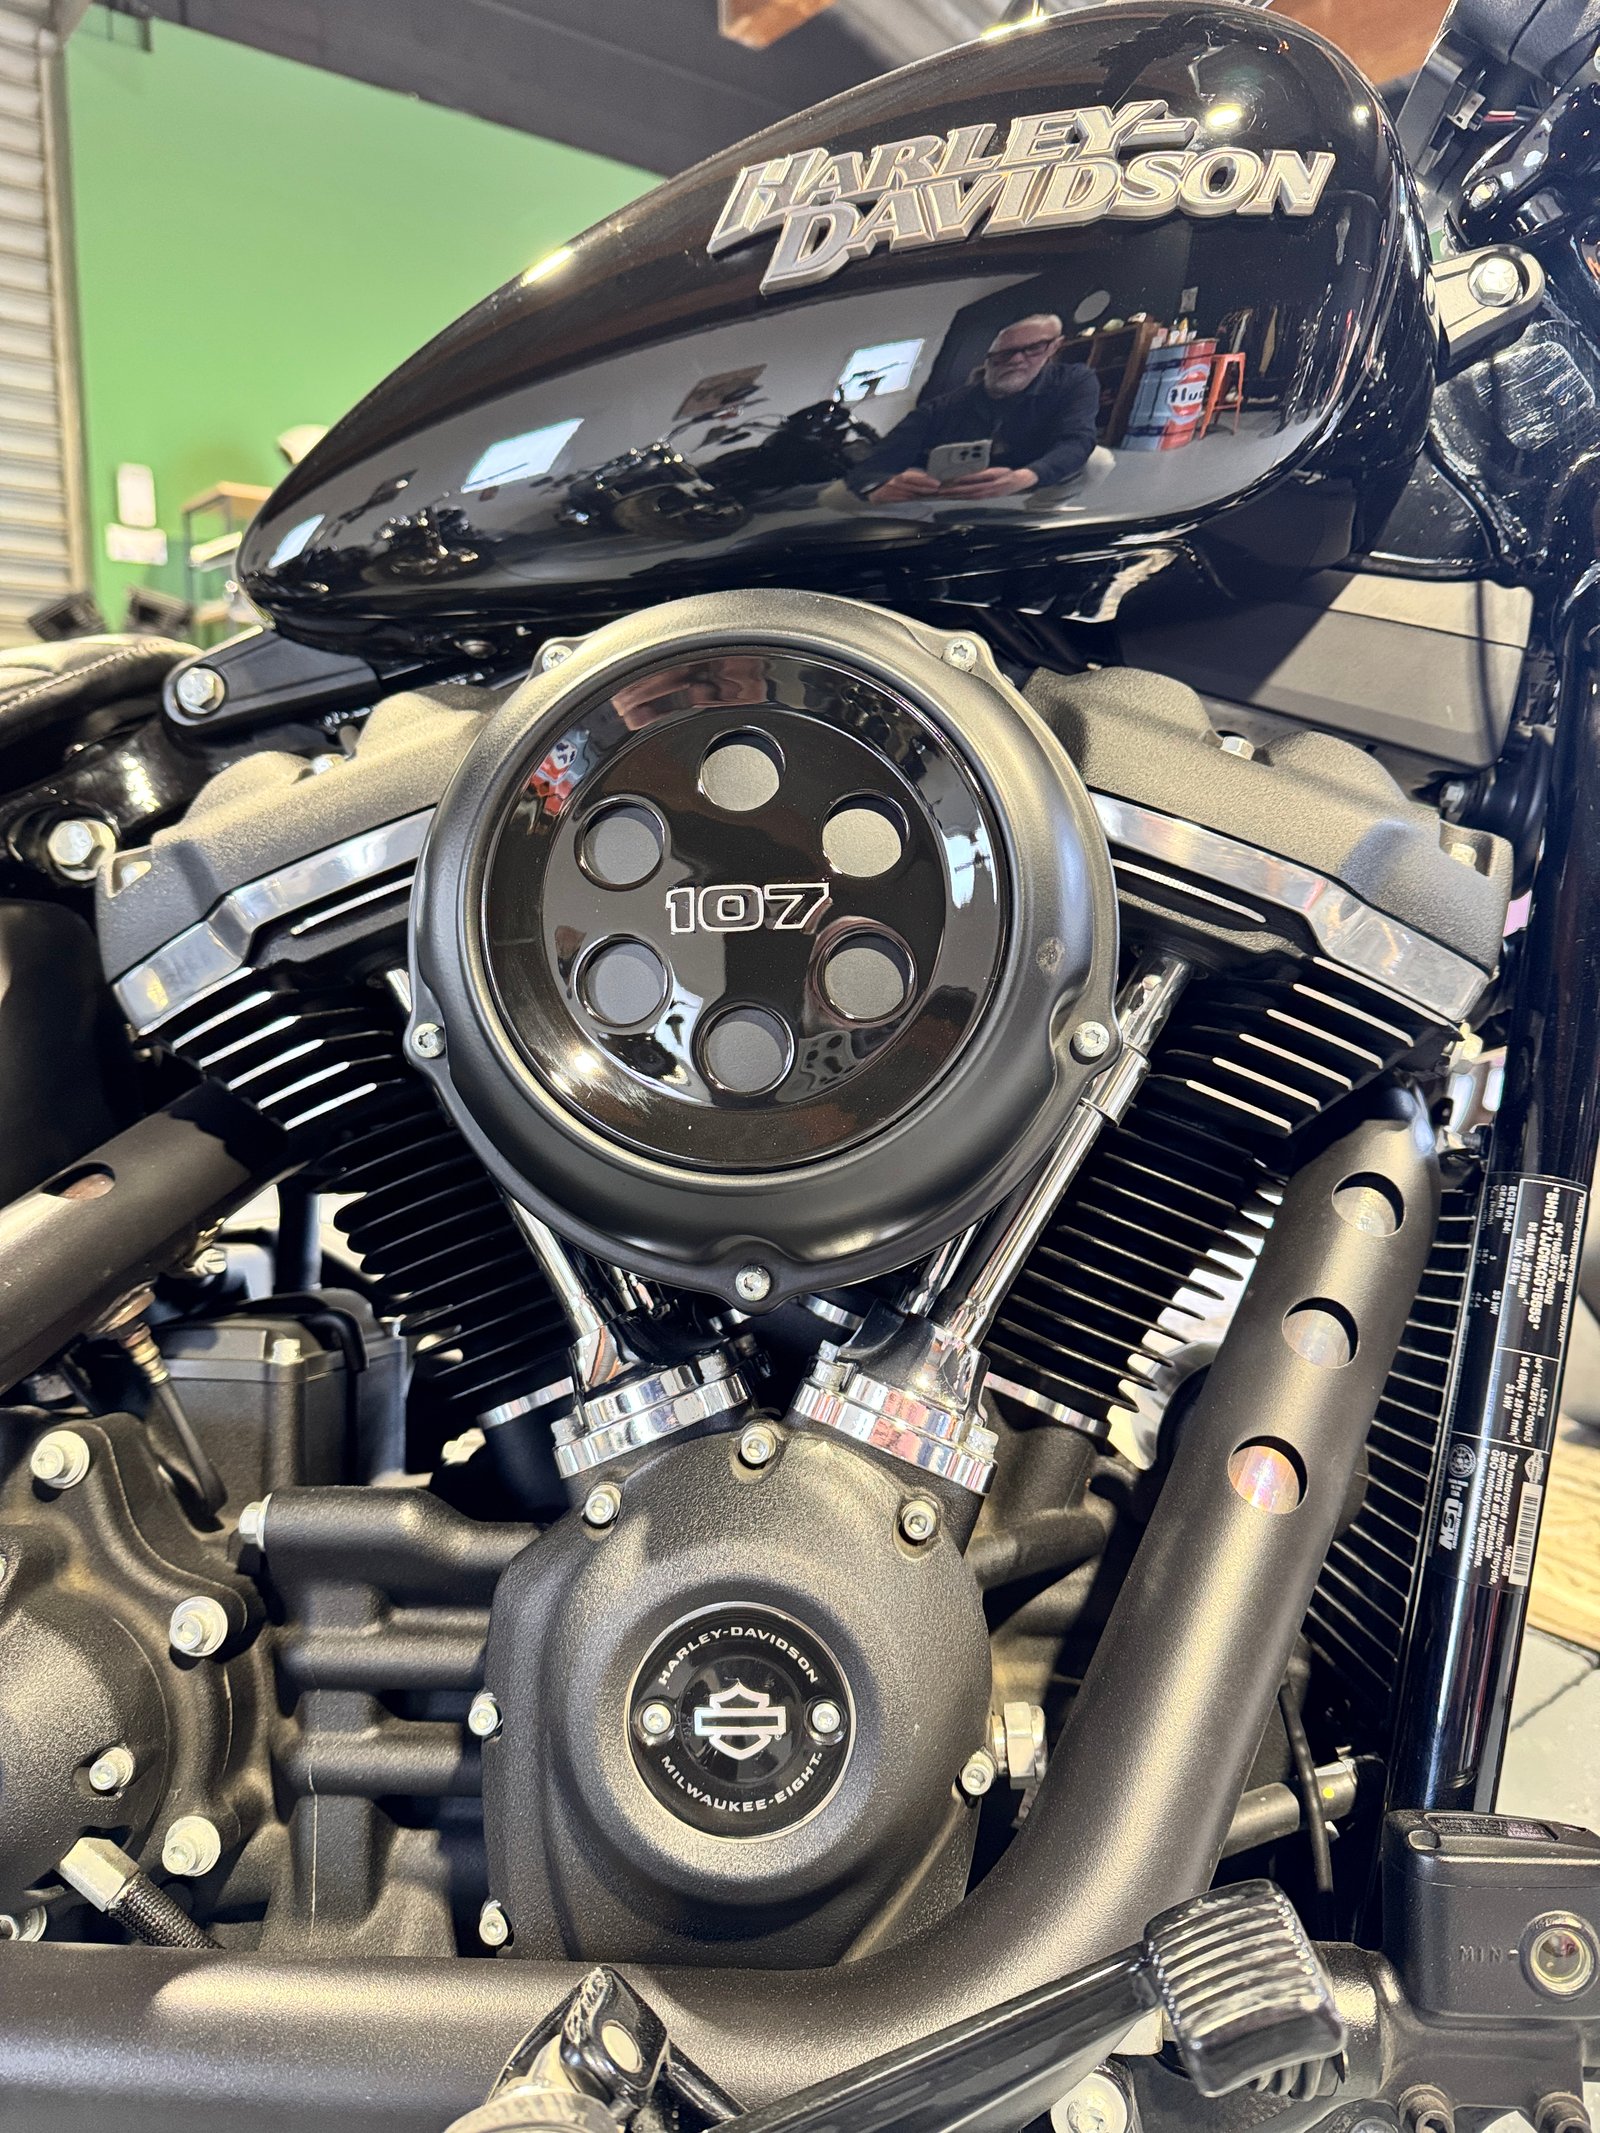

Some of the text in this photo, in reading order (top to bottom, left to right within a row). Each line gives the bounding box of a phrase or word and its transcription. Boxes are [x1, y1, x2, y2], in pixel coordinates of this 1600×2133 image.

[707, 100, 1196, 254] HARLEY-
[759, 149, 1335, 295] DAVIDSON
[665, 882, 830, 936] 107
[1497, 1185, 1507, 1207] GEAR
[1513, 1238, 1524, 1256] MAX
[1508, 1274, 1518, 1284] kg
[1556, 1196, 1584, 1342] HARLEY-DAVIDSON MOTOR COMPANY
[1490, 1301, 1499, 1314] kW
[1491, 1290, 1500, 1300] 33
[1502, 1383, 1514, 1409] 33 kW
[1507, 1453, 1517, 1469] The
[1480, 1470, 1497, 1517] motorcycle
[1484, 1451, 1509, 1558] conforms to all applicable
[1498, 1470, 1515, 1517] motorcycle
[1472, 1519, 1488, 1568] regulations.
[1495, 1524, 1506, 1550] motor
[658, 1626, 819, 1686] HARLEY-DAVIDSON
[1460, 1945, 1502, 1961] MIN
